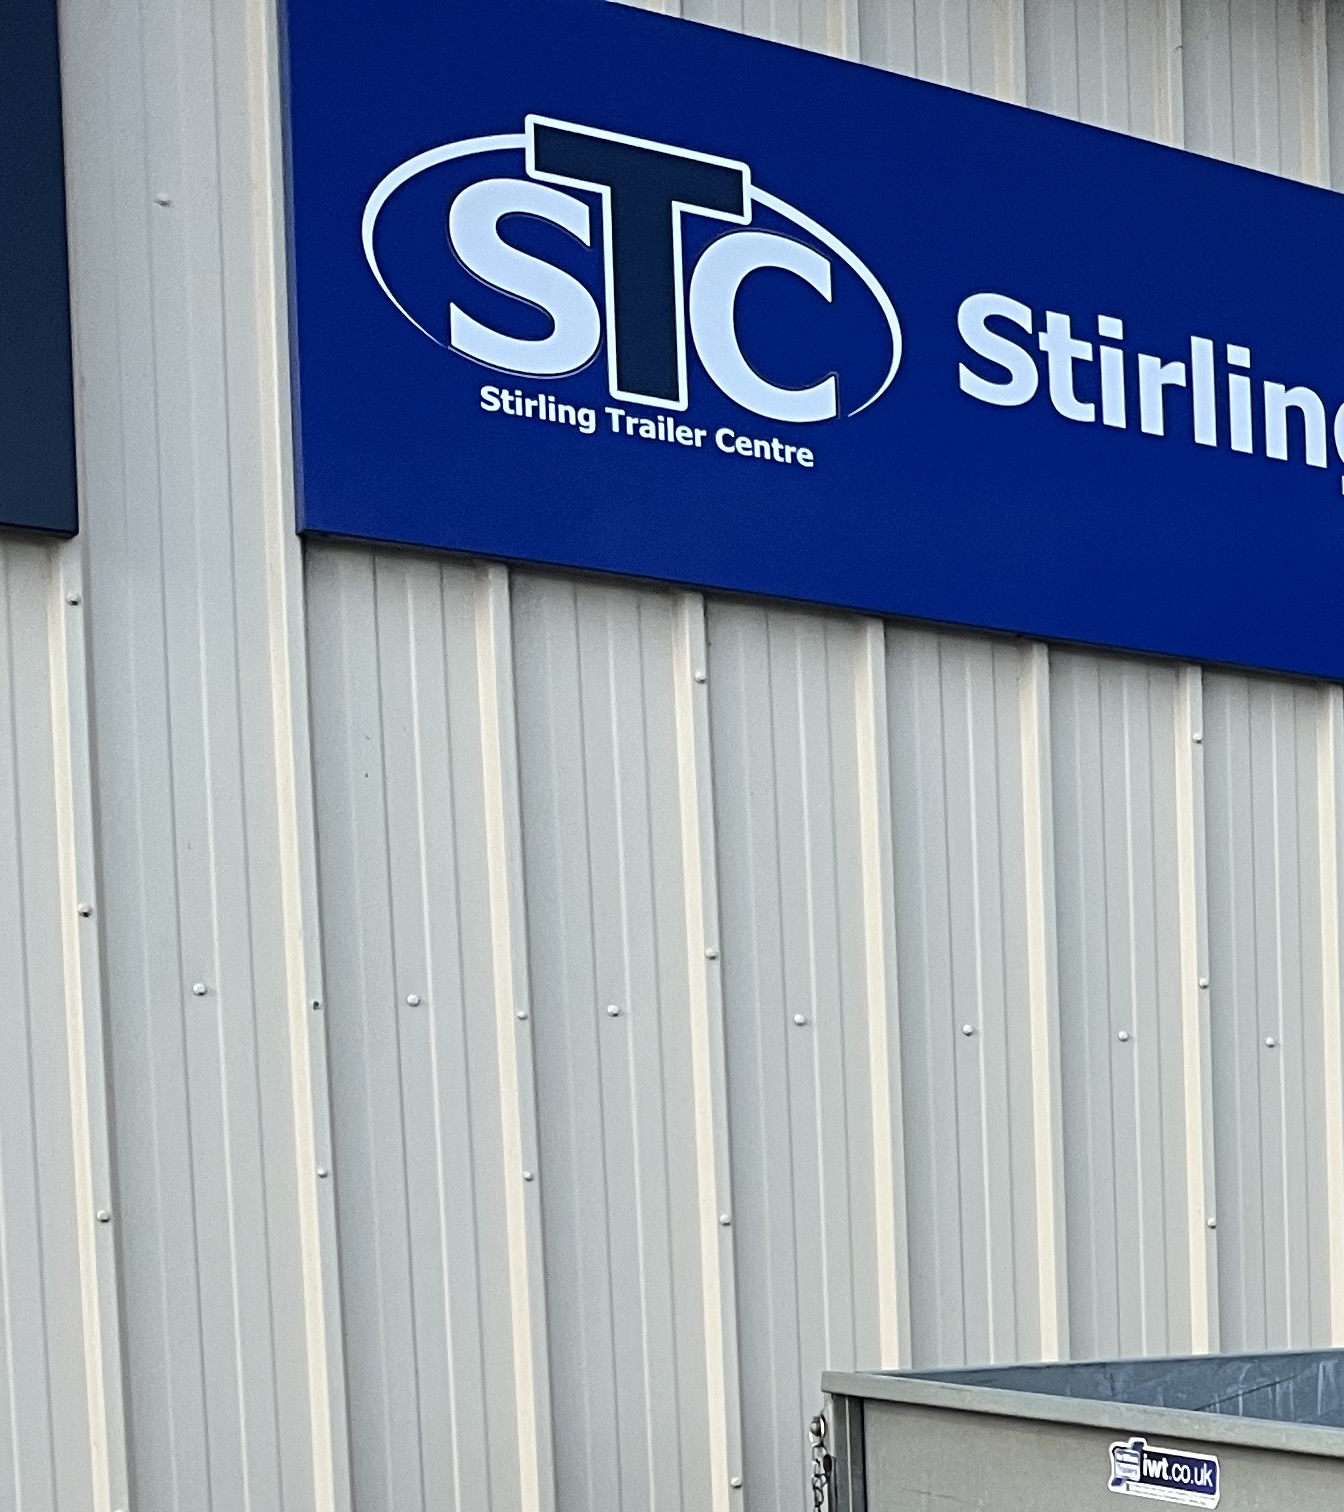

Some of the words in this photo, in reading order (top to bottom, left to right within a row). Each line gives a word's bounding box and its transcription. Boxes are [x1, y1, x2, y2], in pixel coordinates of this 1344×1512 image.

[446, 113, 838, 423] STC
[480, 385, 596, 435] Stirling
[604, 405, 707, 448] Trailer
[715, 428, 815, 467] Centre
[1142, 1453, 1214, 1488] iwt.co.uk
